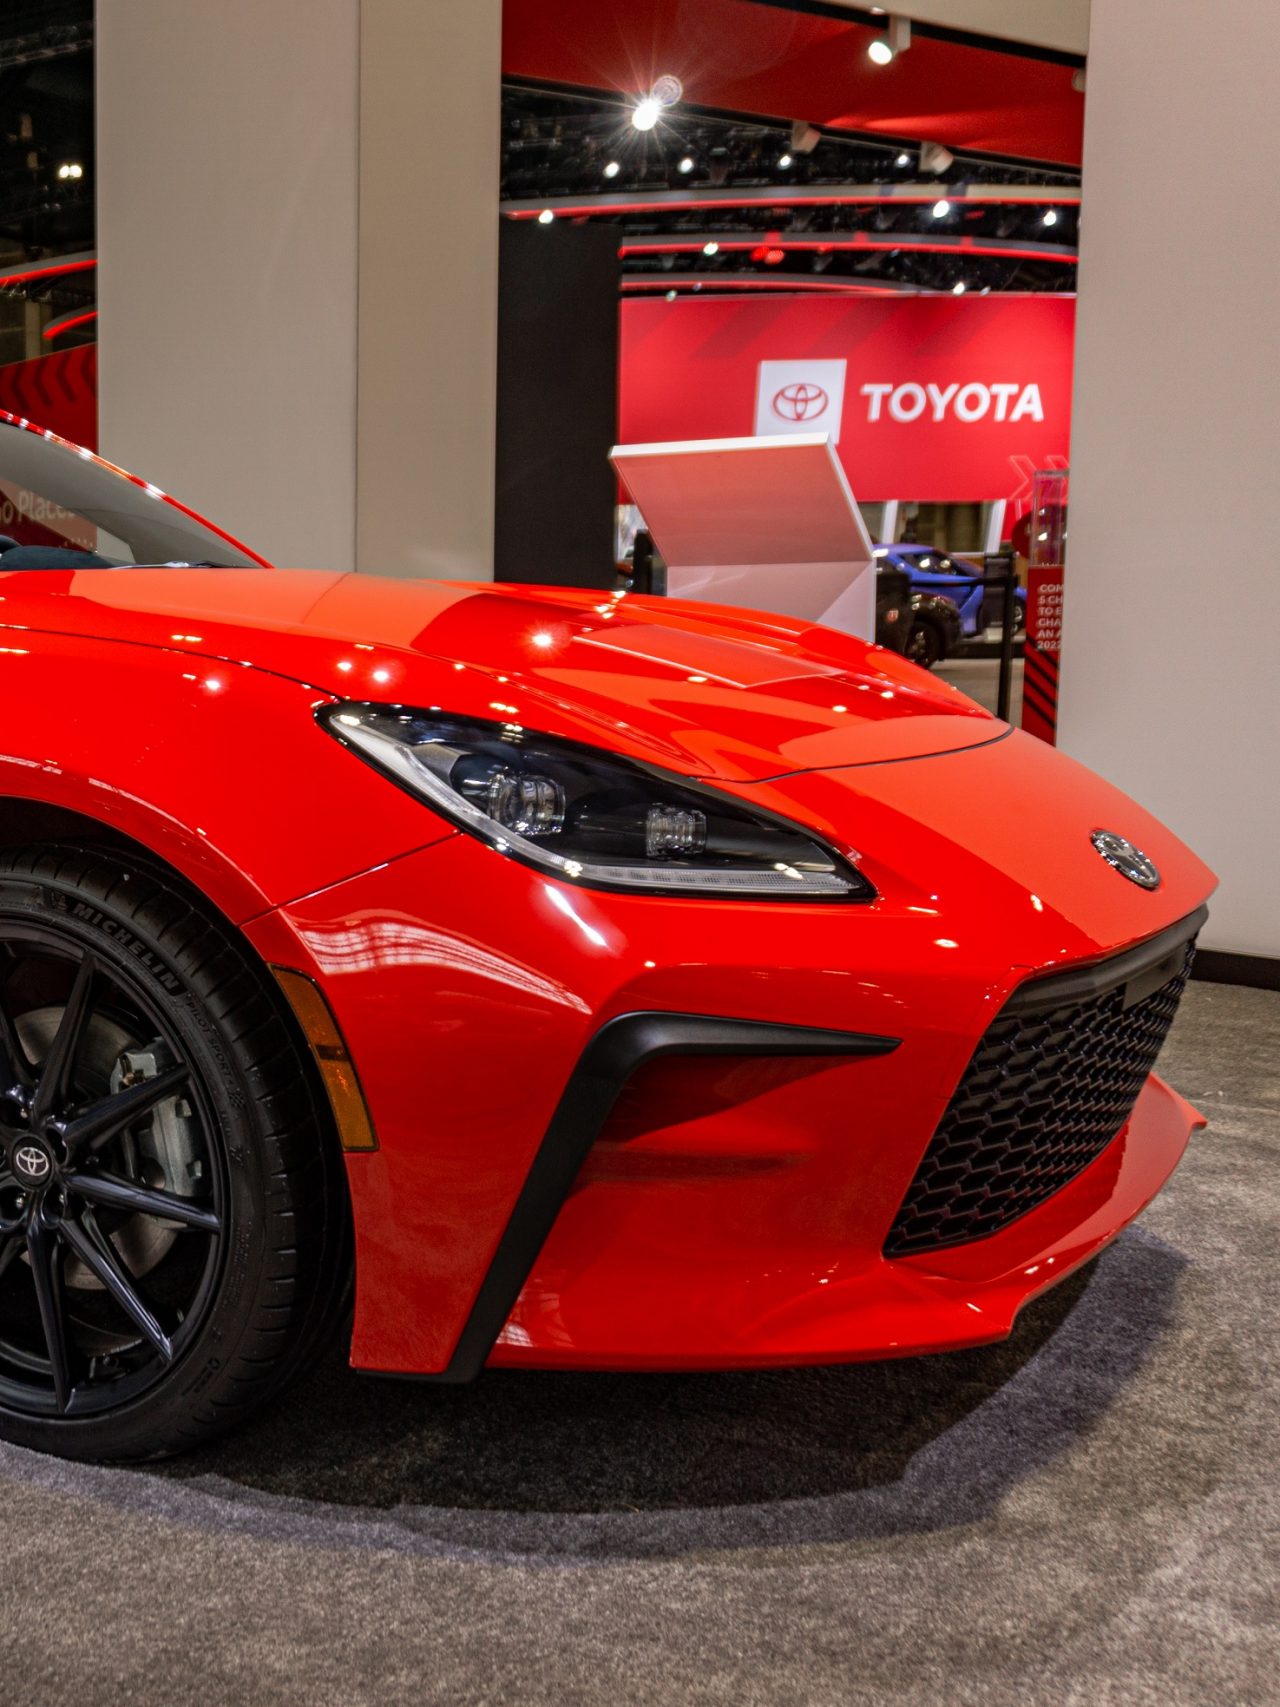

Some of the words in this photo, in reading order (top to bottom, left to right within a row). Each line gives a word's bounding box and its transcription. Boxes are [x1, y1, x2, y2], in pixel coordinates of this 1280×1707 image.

[859, 382, 1045, 423] TOYOTA
[1038, 606, 1053, 616] TO
[1037, 628, 1054, 638] AN
[73, 903, 180, 991] MICHELIN
[187, 1002, 211, 1034] PILOT
[208, 1037, 232, 1078] SPORT
